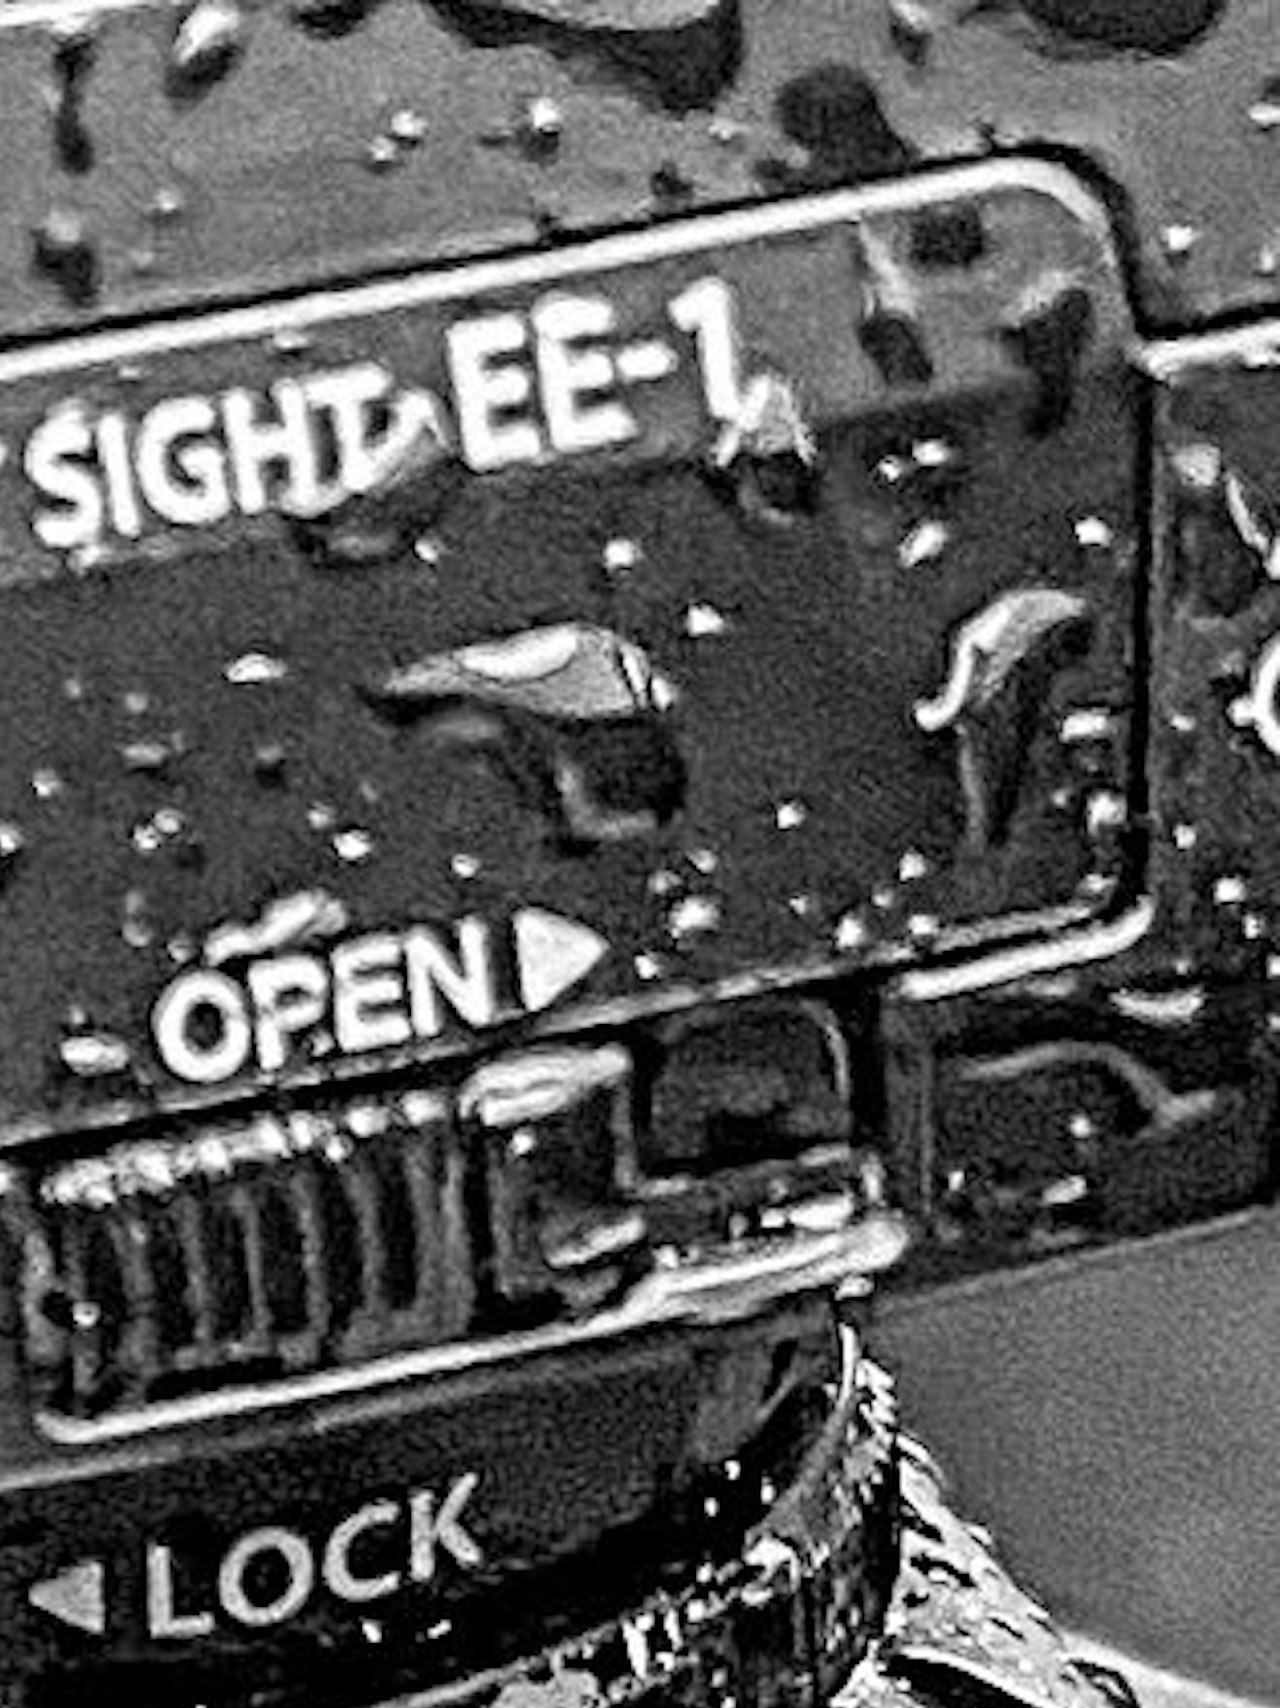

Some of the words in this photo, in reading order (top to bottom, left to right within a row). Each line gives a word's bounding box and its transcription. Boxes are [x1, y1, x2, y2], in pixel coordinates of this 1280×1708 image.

[24, 363, 396, 548] SIGHT
[447, 276, 744, 474] EE-1
[151, 911, 493, 1084] OPEN
[145, 1472, 484, 1640] LOCK
